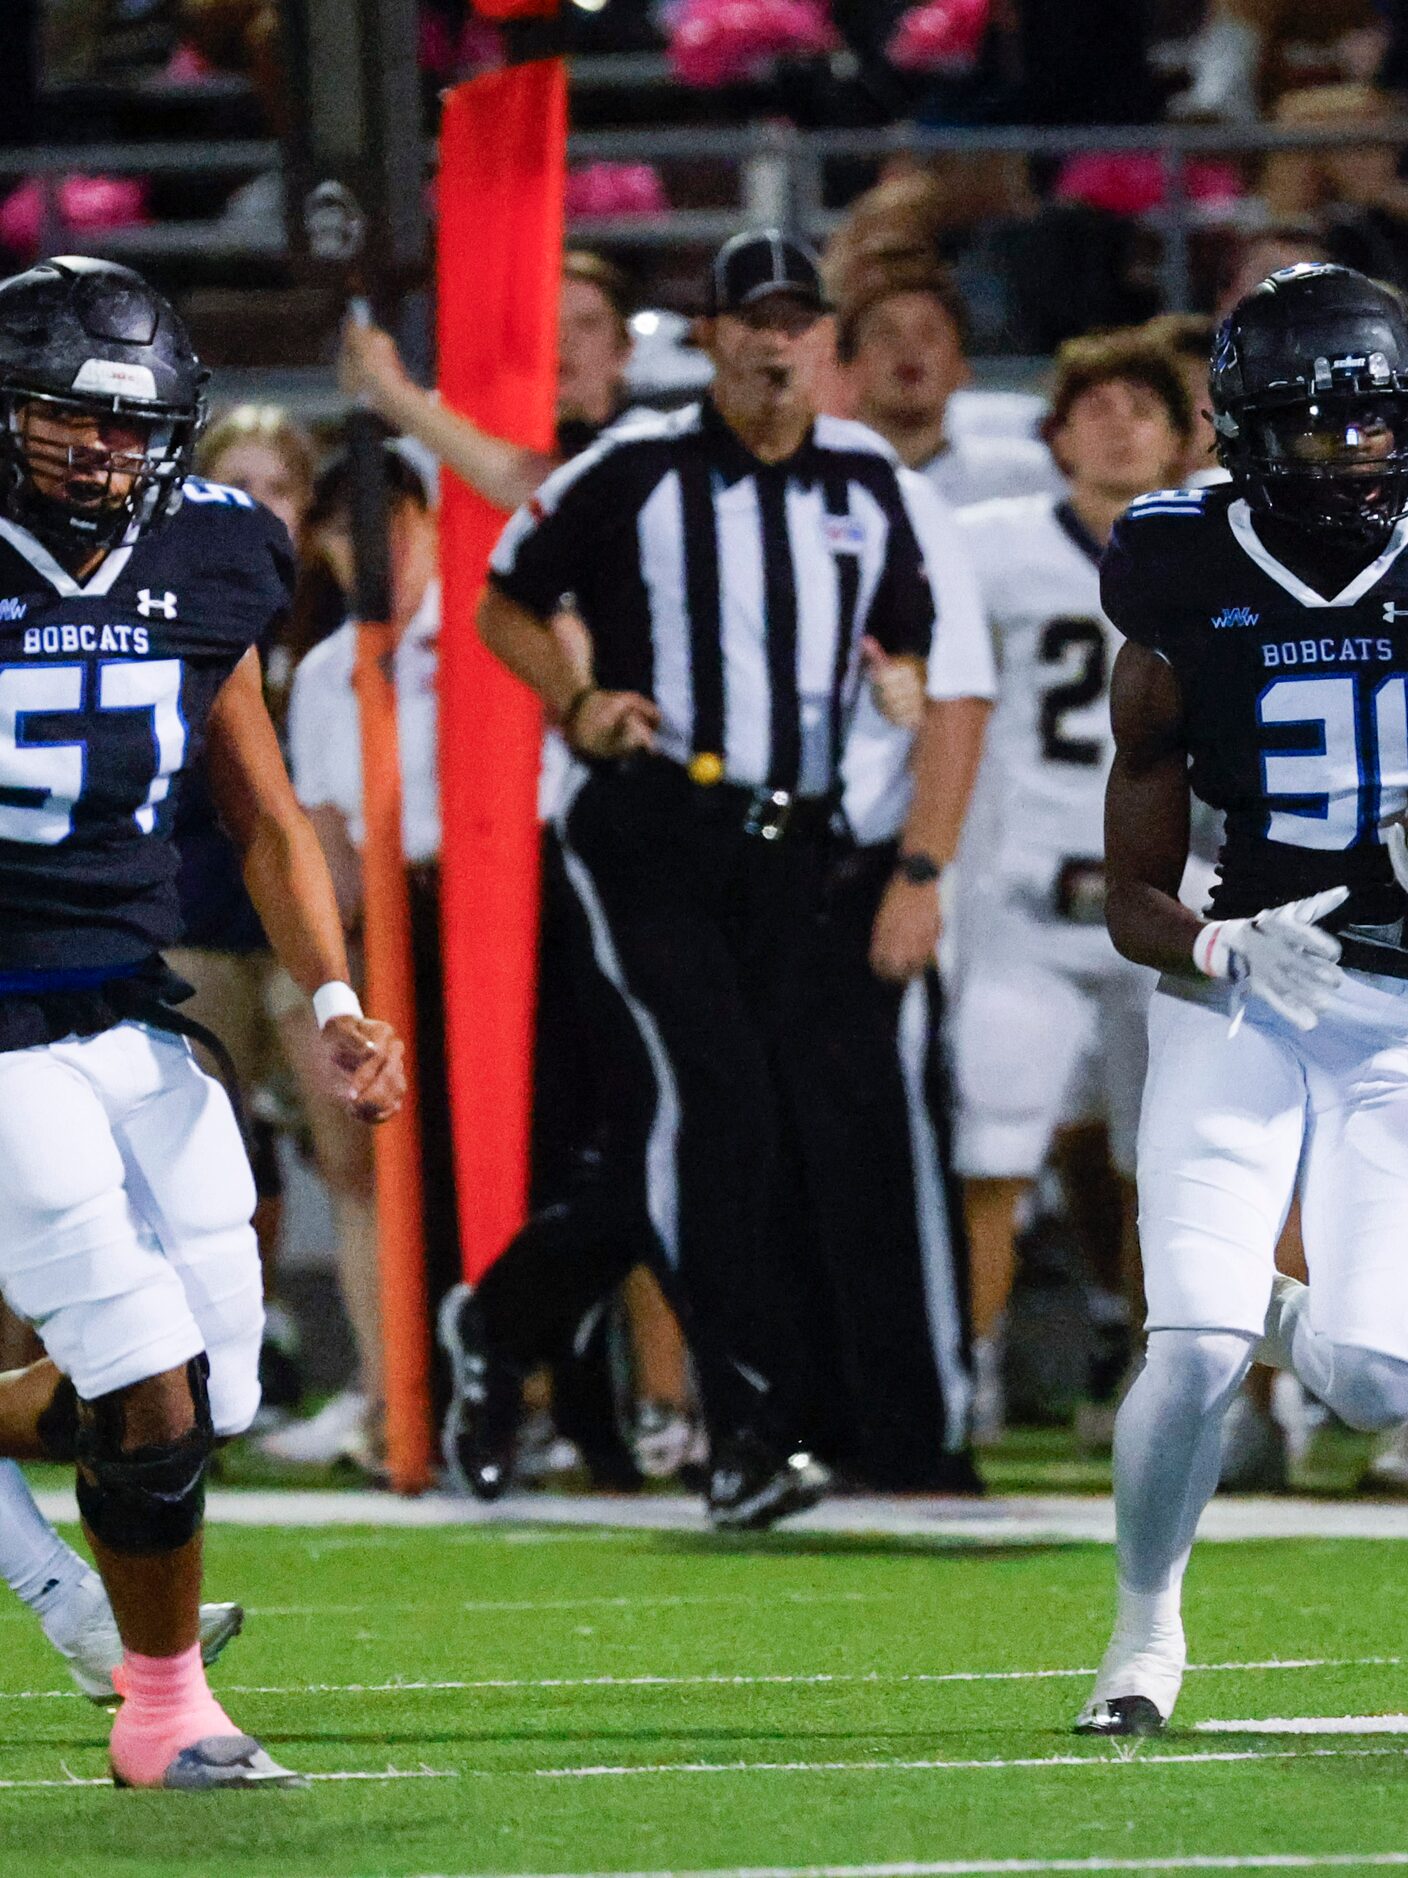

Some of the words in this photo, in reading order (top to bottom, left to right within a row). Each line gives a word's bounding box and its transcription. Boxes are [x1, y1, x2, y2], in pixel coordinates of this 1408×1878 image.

[182, 482, 254, 508] 5
[23, 624, 150, 655] BOBCATS
[1262, 638, 1393, 667] BOBCATS
[0, 658, 187, 845] 57
